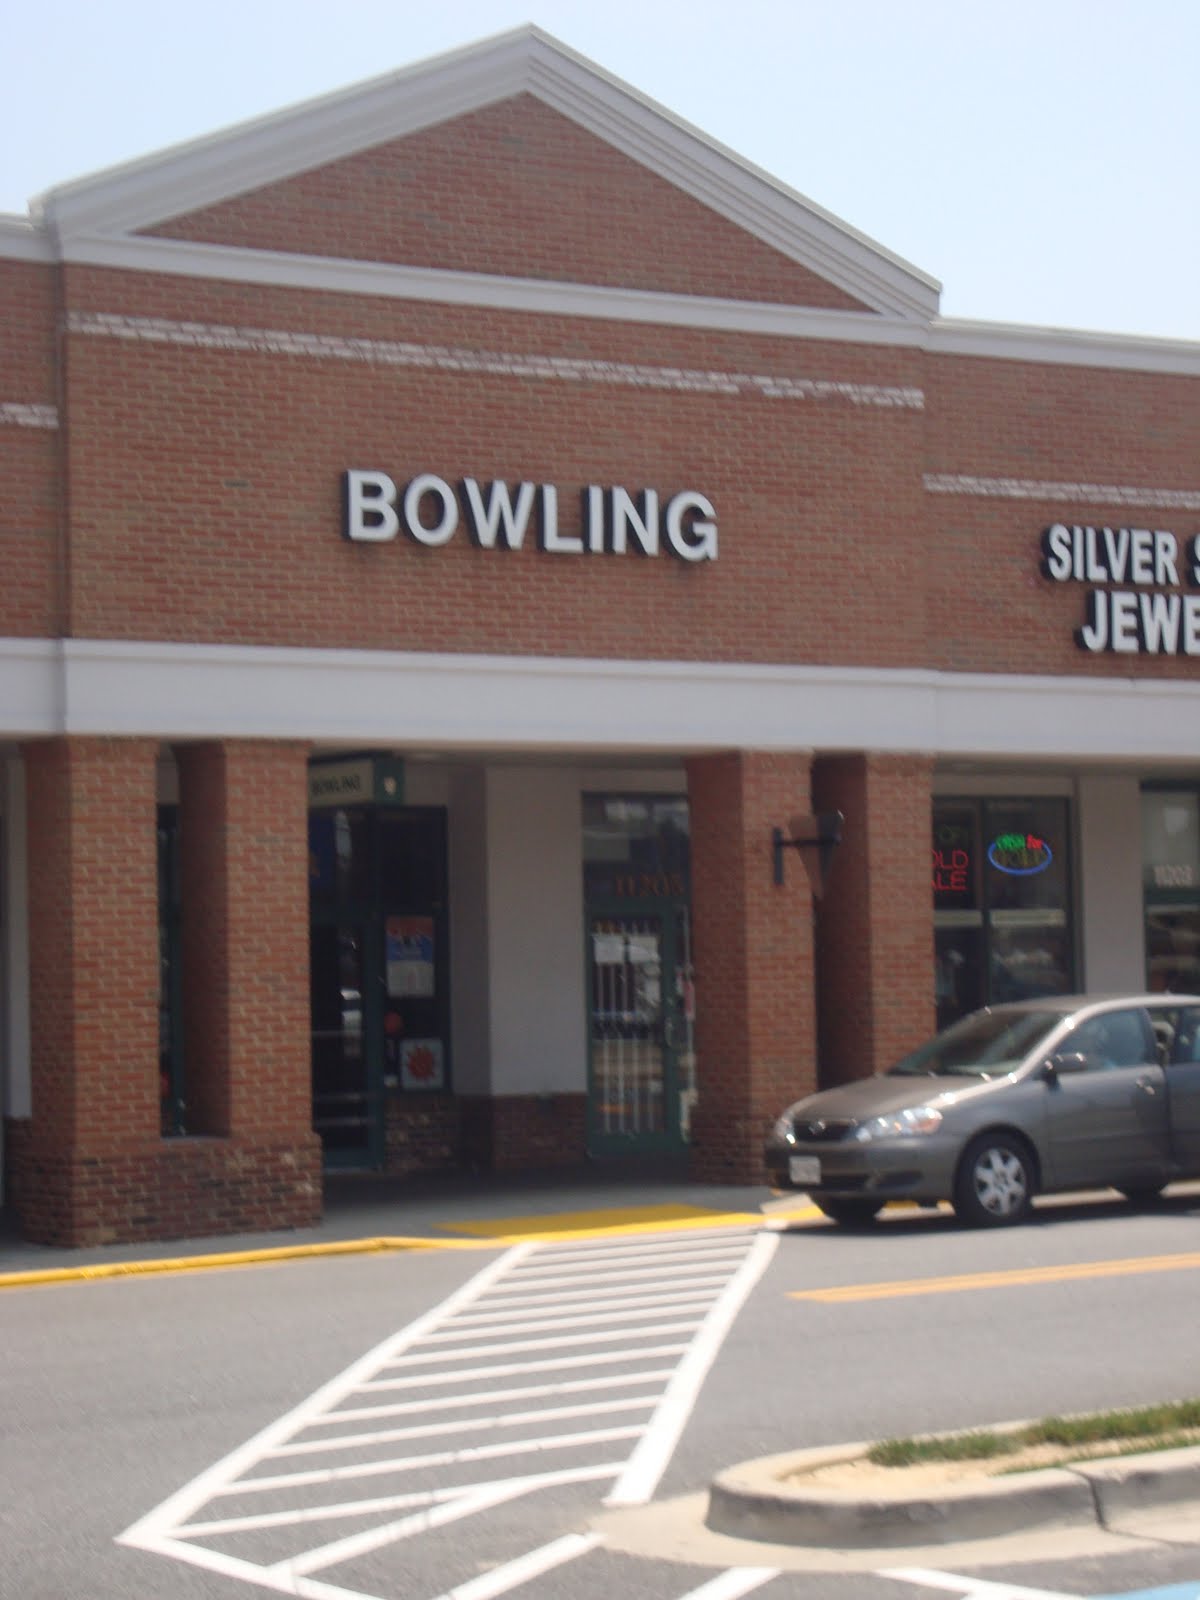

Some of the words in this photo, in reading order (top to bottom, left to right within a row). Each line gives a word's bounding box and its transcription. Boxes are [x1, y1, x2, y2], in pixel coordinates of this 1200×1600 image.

[346, 469, 719, 562] BOWLING
[1047, 523, 1181, 587] SILVER
[1081, 589, 1200, 656] JEWE
